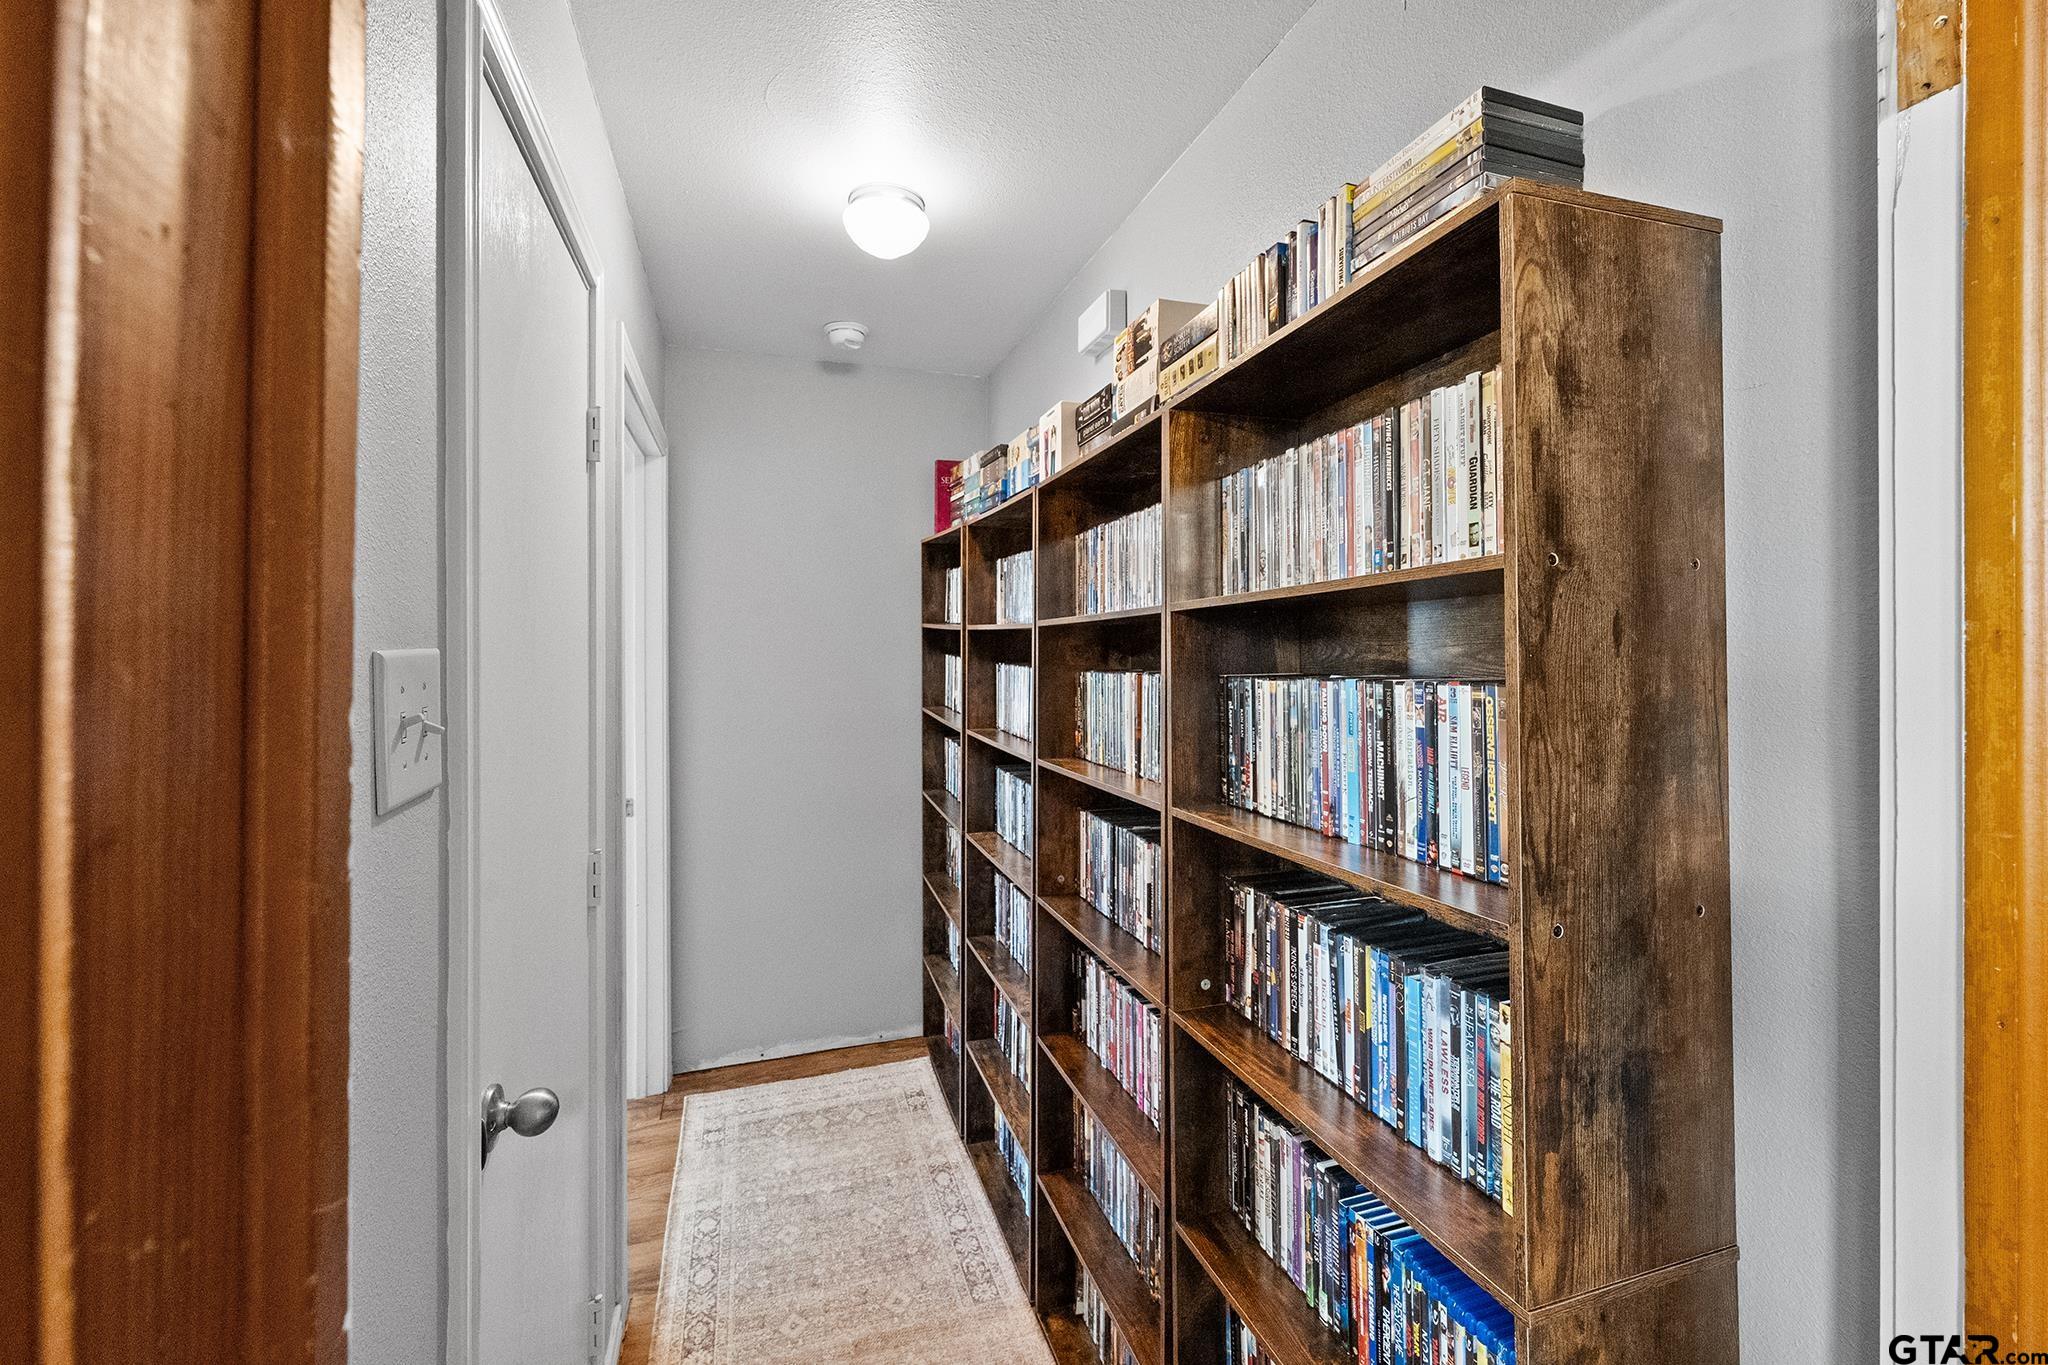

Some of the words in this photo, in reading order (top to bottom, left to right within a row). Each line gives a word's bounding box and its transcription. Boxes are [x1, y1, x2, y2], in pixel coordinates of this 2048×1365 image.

[1433, 417, 1442, 444] FIFTY
[1433, 445, 1442, 483] SHADES
[1469, 456, 1479, 511] GUARDIAN
[1438, 697, 1448, 723] AIR
[1486, 696, 1496, 760] OBSERVE
[1377, 740, 1385, 800] MACHINIST
[1407, 726, 1415, 790] Adaptation.
[1450, 735, 1459, 770] ELLIOTT
[1461, 766, 1470, 791] LEGEND
[1488, 763, 1498, 825] REPORT
[1395, 972, 1404, 1015] TROY
[1441, 1029, 1449, 1095] LAWLESS
[1491, 1100, 1501, 1130] ROAD
[1503, 1077, 1513, 1147] GANDHI
[1383, 1306, 1391, 1365] DIVERGENT
